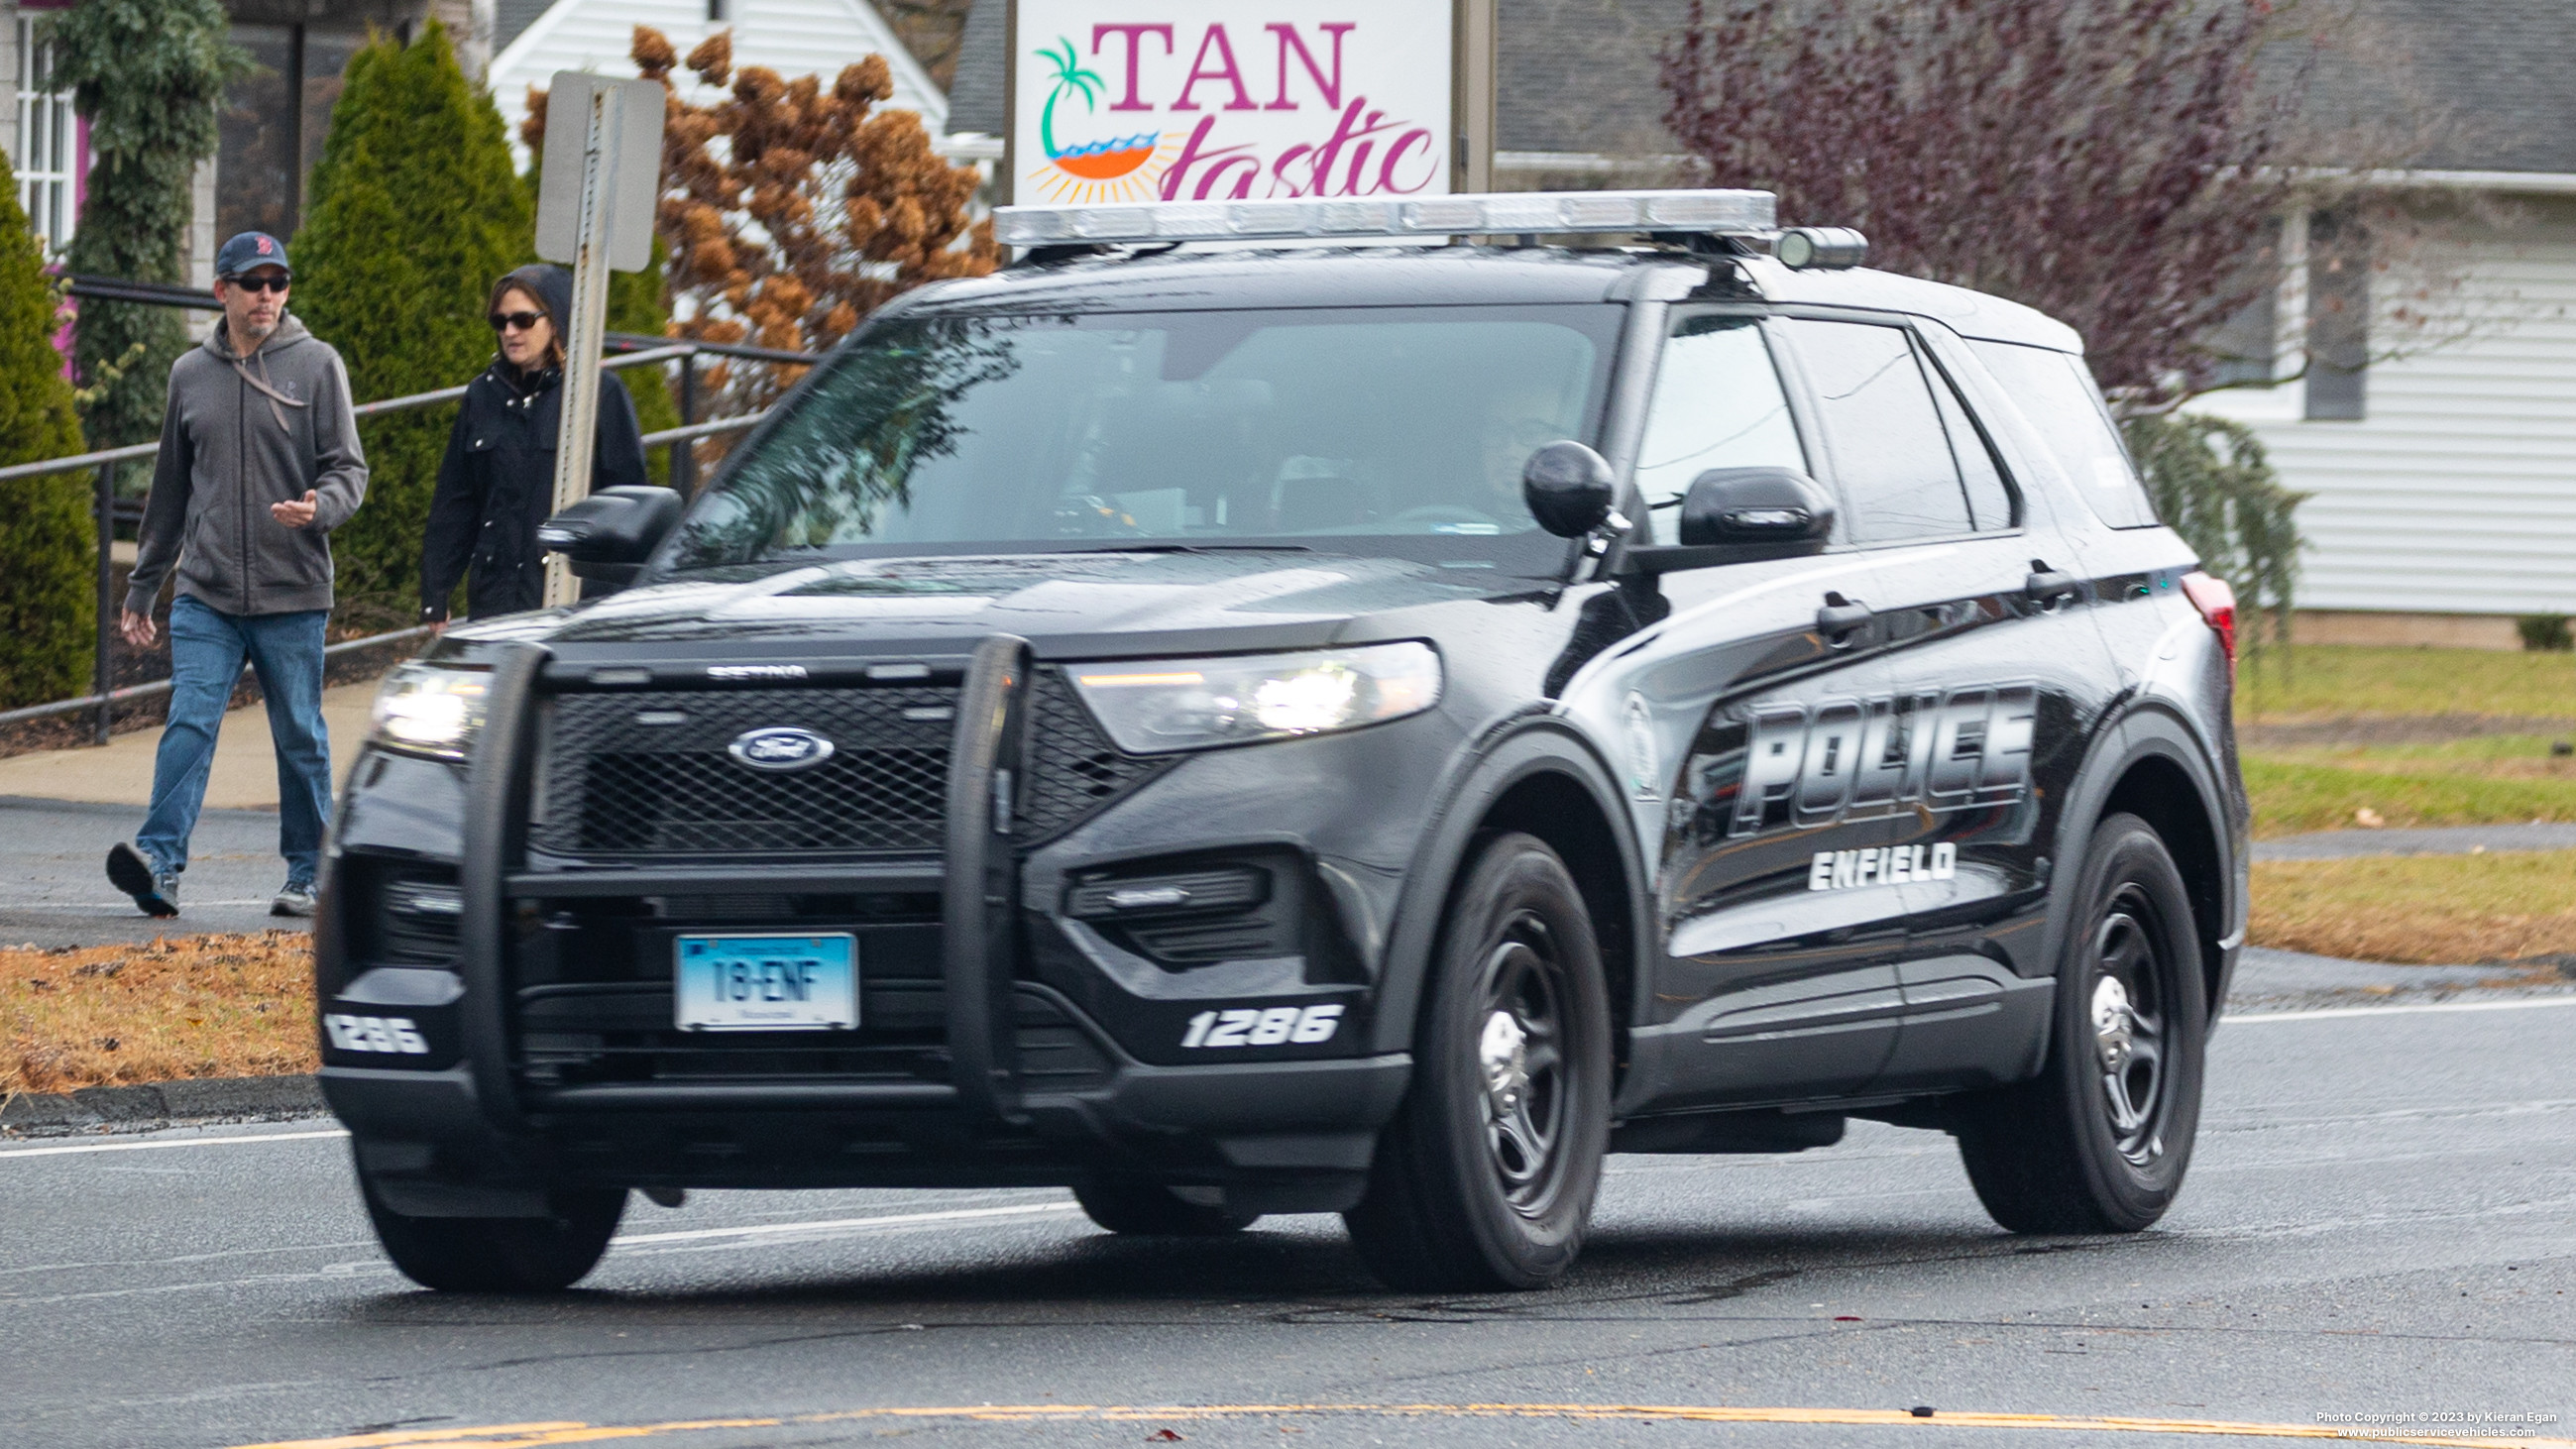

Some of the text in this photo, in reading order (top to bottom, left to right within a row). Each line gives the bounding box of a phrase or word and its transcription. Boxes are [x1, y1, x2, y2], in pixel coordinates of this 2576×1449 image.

[1091, 22, 1357, 111] TAN
[1158, 96, 1440, 201] tastic
[1728, 675, 2040, 838] POLICE
[1808, 841, 1957, 891] ENFIELD
[713, 958, 821, 1002] 18-ENF
[323, 1014, 429, 1054] 1286
[1179, 1004, 1346, 1048] 1286
